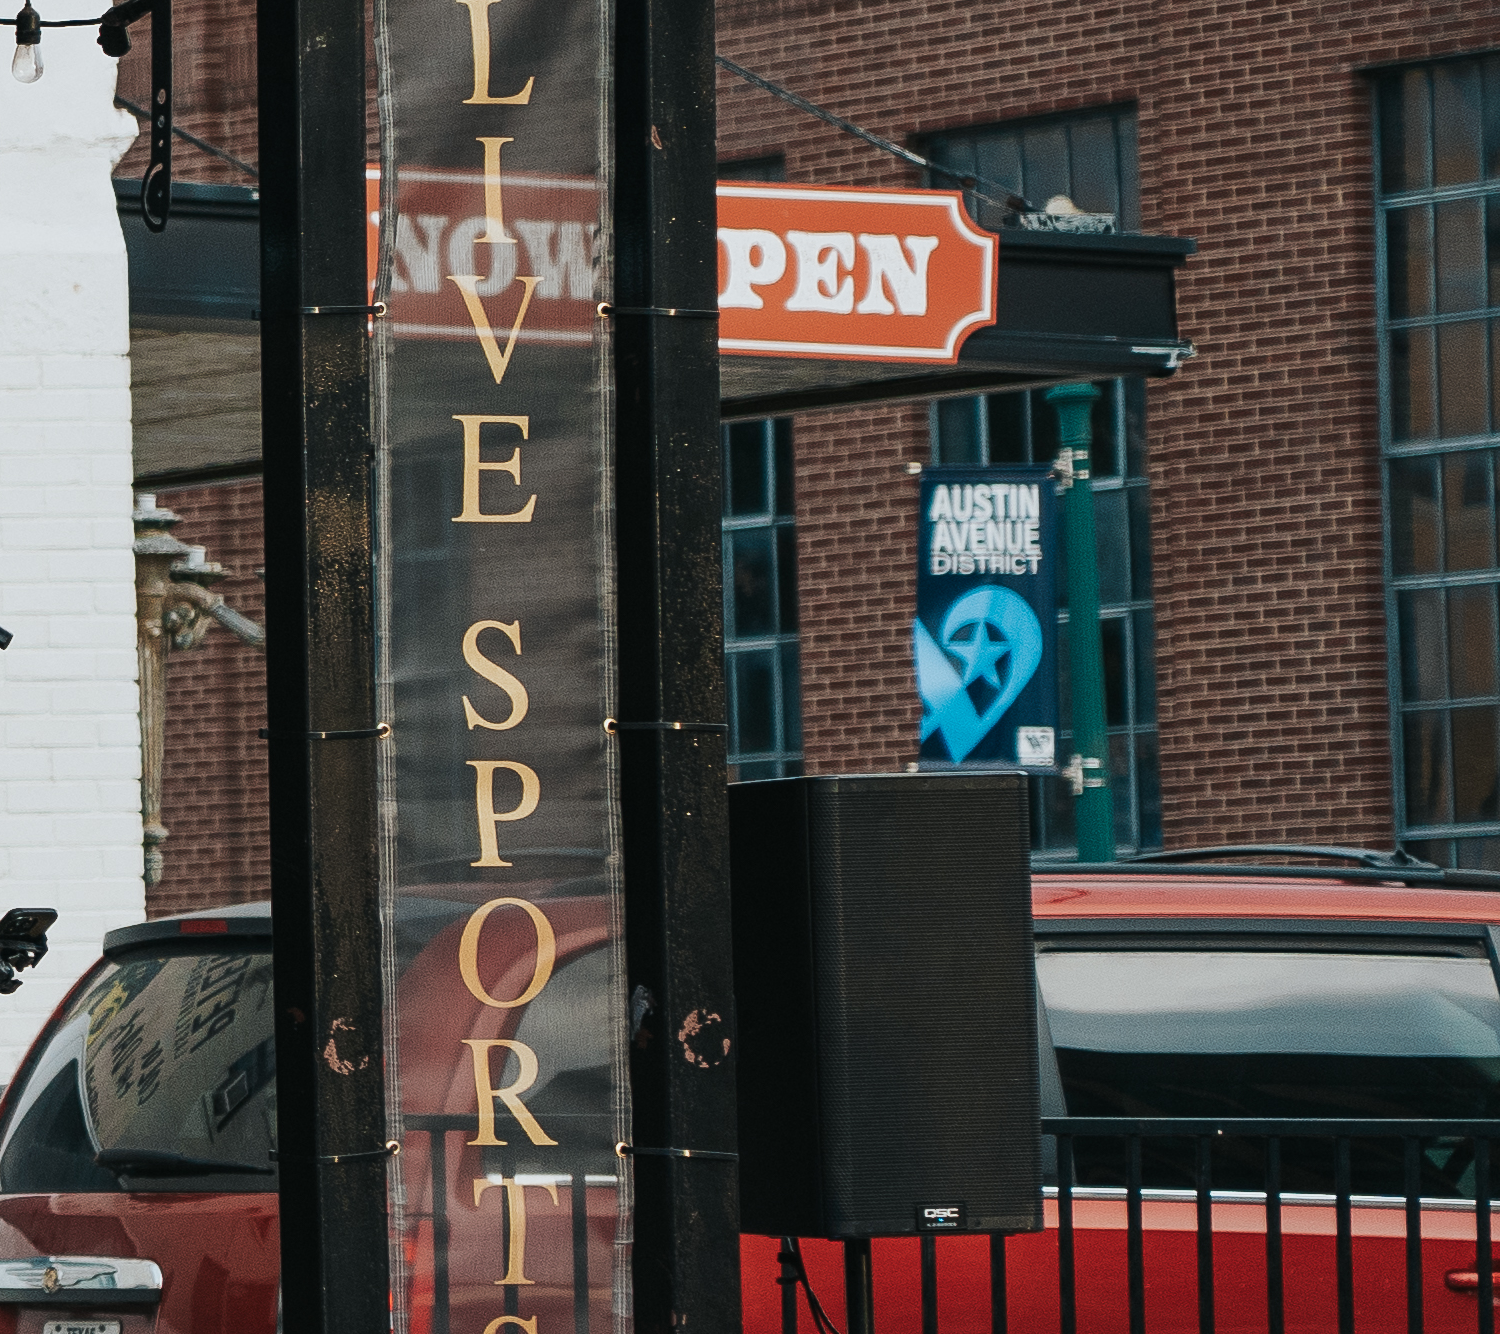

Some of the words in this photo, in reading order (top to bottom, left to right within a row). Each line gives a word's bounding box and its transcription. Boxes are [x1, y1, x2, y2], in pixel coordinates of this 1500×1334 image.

[716, 227, 940, 317] PEN
[929, 484, 1040, 521] AUSTIN
[932, 521, 1041, 553] AVENUE
[929, 552, 1043, 576] DISTRICT
[924, 1208, 959, 1218] QSC
